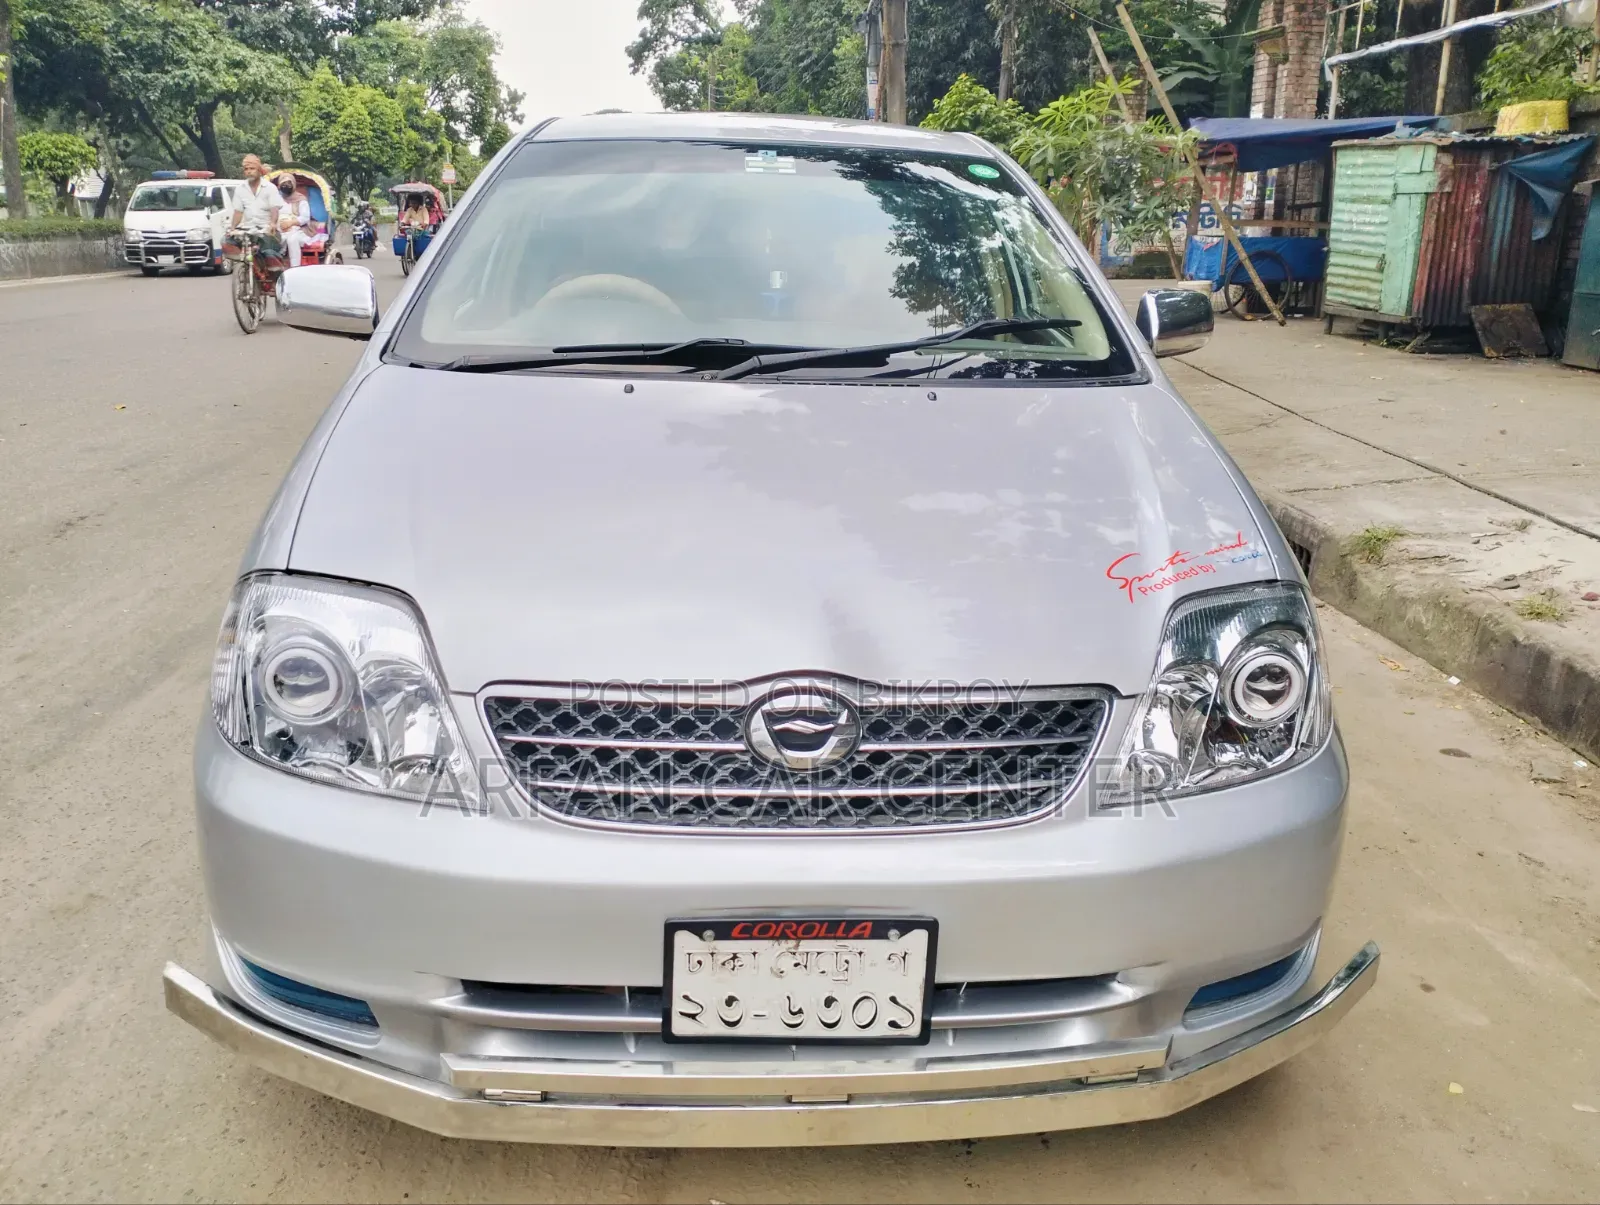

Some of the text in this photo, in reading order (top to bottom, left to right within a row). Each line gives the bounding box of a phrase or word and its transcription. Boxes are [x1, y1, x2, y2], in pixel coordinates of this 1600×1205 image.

[1137, 563, 1217, 597] Produced by
[730, 921, 873, 939] COROLLA
[685, 949, 760, 976] ঢাকা
